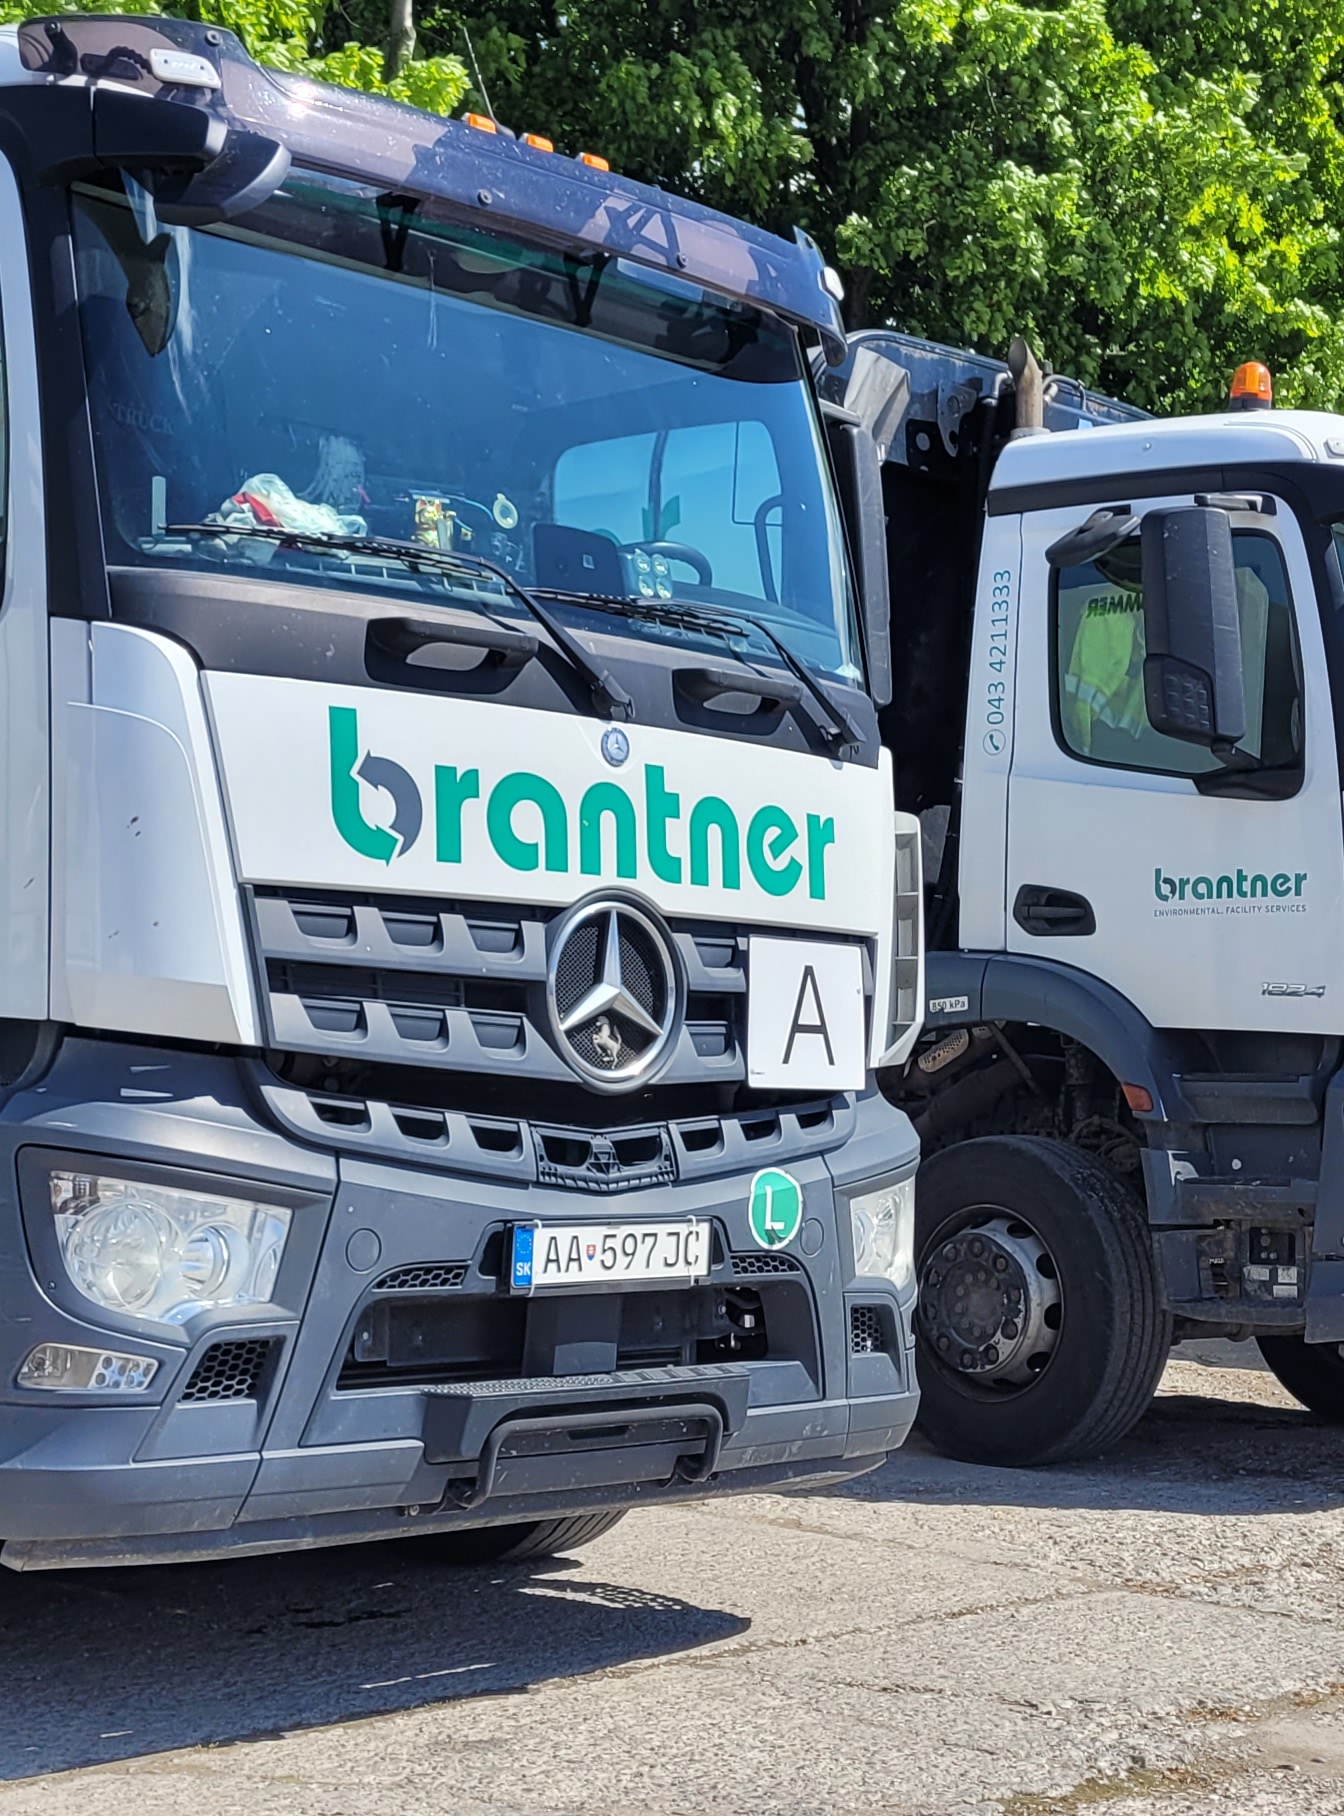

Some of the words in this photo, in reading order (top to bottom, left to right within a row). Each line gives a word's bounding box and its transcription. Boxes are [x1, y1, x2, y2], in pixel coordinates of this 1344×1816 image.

[987, 682, 1005, 725] 043
[329, 706, 836, 900] brantner
[1154, 868, 1308, 902] brantner
[1226, 905, 1263, 915] FACILITY
[1265, 904, 1307, 913] SERVICES
[949, 1000, 966, 1009] kPa
[1261, 982, 1327, 998] 1824
[782, 965, 836, 1066] A
[764, 1185, 785, 1231] L
[516, 1262, 531, 1276] SK
